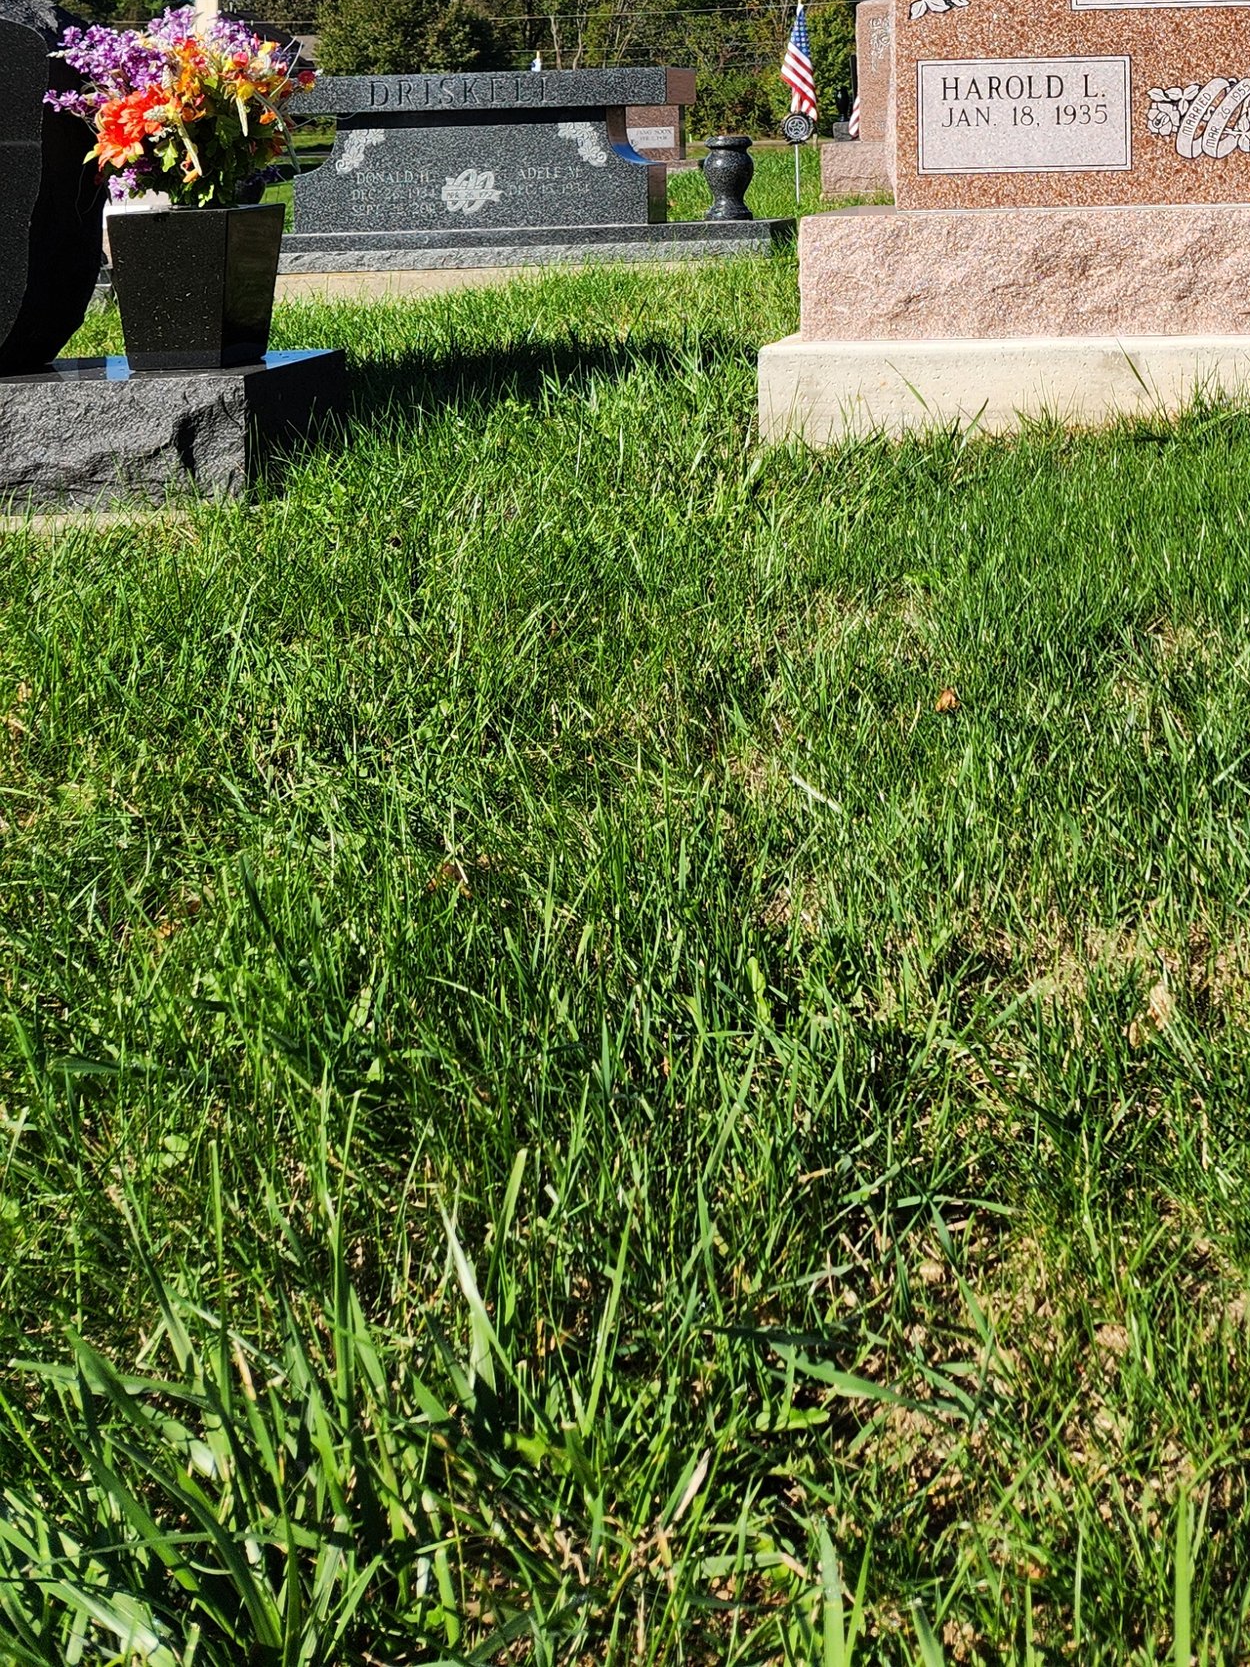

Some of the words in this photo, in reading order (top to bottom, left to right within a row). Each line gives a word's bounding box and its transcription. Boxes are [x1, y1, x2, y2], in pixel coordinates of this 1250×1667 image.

[369, 76, 556, 107] DRISKELL
[941, 75, 1064, 101] HAROLD
[1083, 74, 1106, 98] L.
[941, 106, 997, 127] JAN.
[1055, 104, 1108, 125] 1935
[1182, 92, 1212, 137] MARRIED
[1206, 126, 1222, 149] MAR.
[1230, 83, 1250, 103] 1955
[356, 170, 413, 185] DONALD
[519, 167, 560, 180] ADELE
